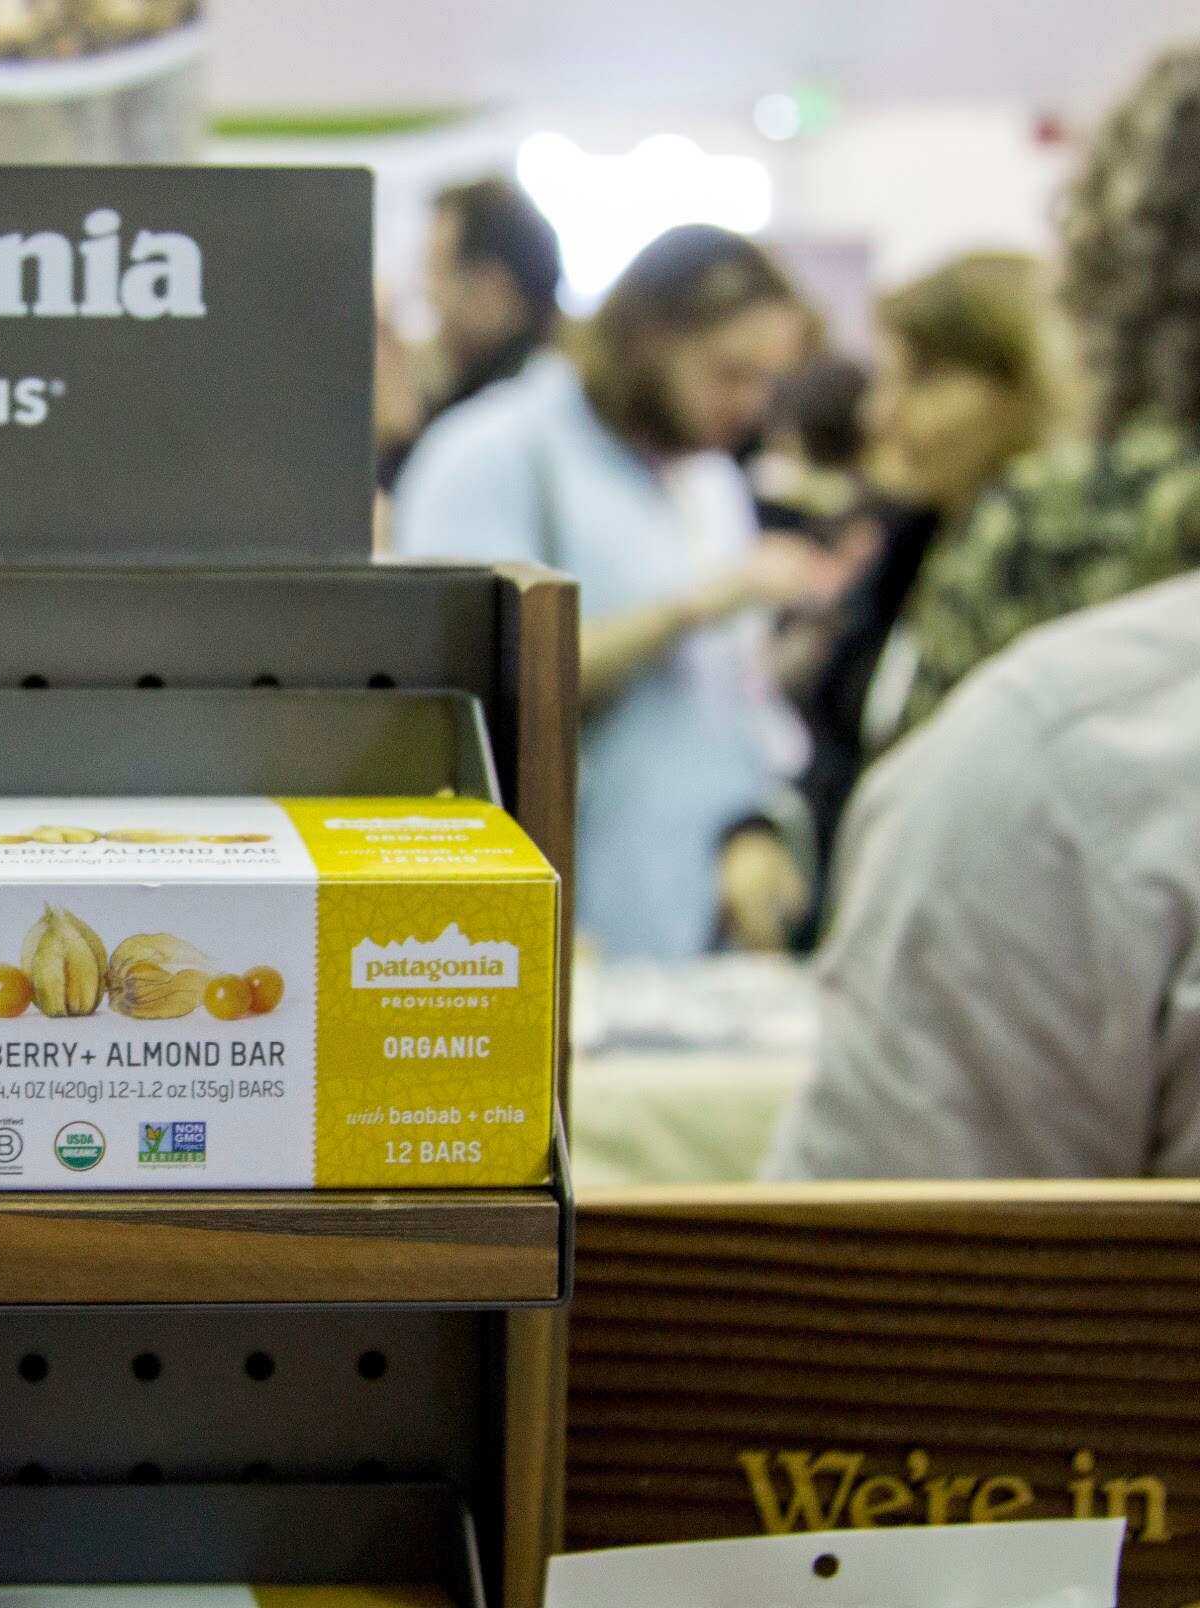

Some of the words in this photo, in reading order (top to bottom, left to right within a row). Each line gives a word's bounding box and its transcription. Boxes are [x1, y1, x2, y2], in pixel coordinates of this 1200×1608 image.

[366, 955, 504, 982] patagonia
[106, 1041, 220, 1067] ALMOND
[231, 1041, 285, 1067] BAR
[384, 1036, 491, 1059] ORGANIC
[24, 1081, 45, 1099] OZ
[49, 1080, 103, 1103] (420g)
[167, 1085, 187, 1099] oz
[191, 1080, 234, 1103] (35g)
[239, 1080, 284, 1098] BARS
[346, 1106, 386, 1126] with
[389, 1106, 462, 1125] baobab
[483, 1105, 526, 1124] chia
[66, 1133, 94, 1144] USDA
[174, 1133, 204, 1143] GMO
[175, 1124, 203, 1133] NON
[385, 1141, 412, 1164] 12
[420, 1141, 482, 1163] BARS
[736, 1448, 1035, 1535] We're
[1067, 1450, 1173, 1543] in
